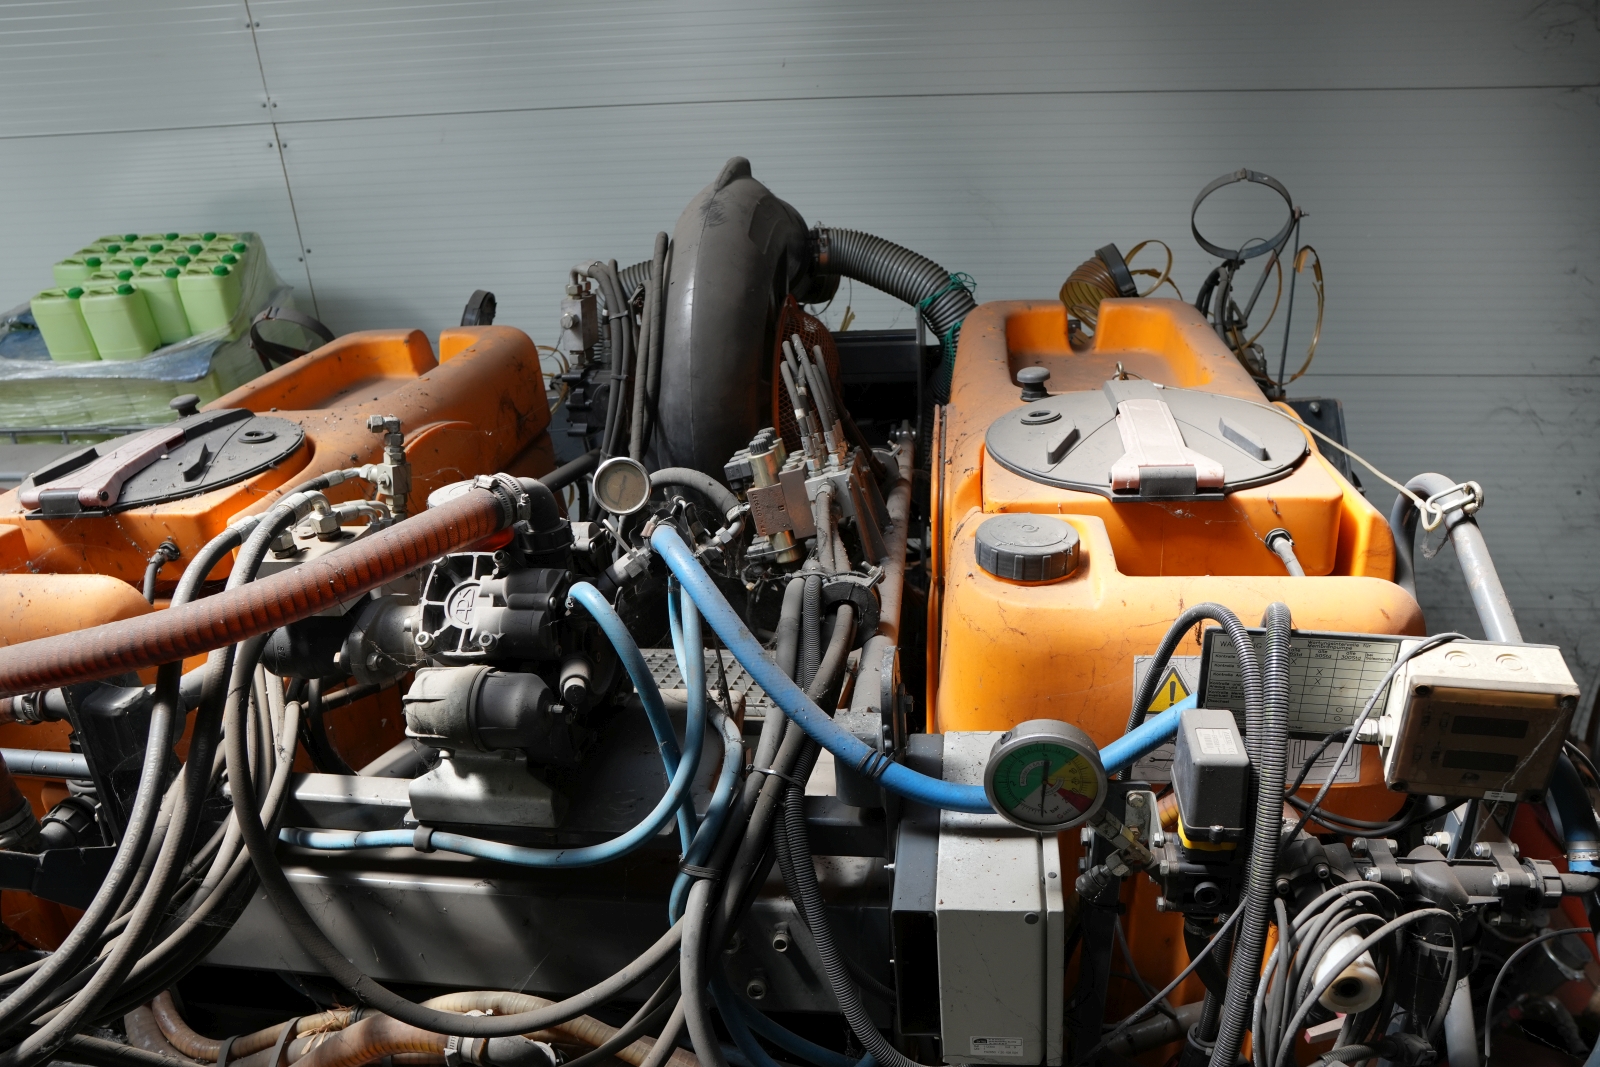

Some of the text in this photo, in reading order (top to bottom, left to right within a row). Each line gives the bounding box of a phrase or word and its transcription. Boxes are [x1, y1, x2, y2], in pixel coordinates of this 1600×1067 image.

[141, 746, 158, 795] HYPRESS
[1068, 767, 1078, 775] 10
[1049, 805, 1060, 814] bar
[114, 819, 140, 871] EXCEEDS
